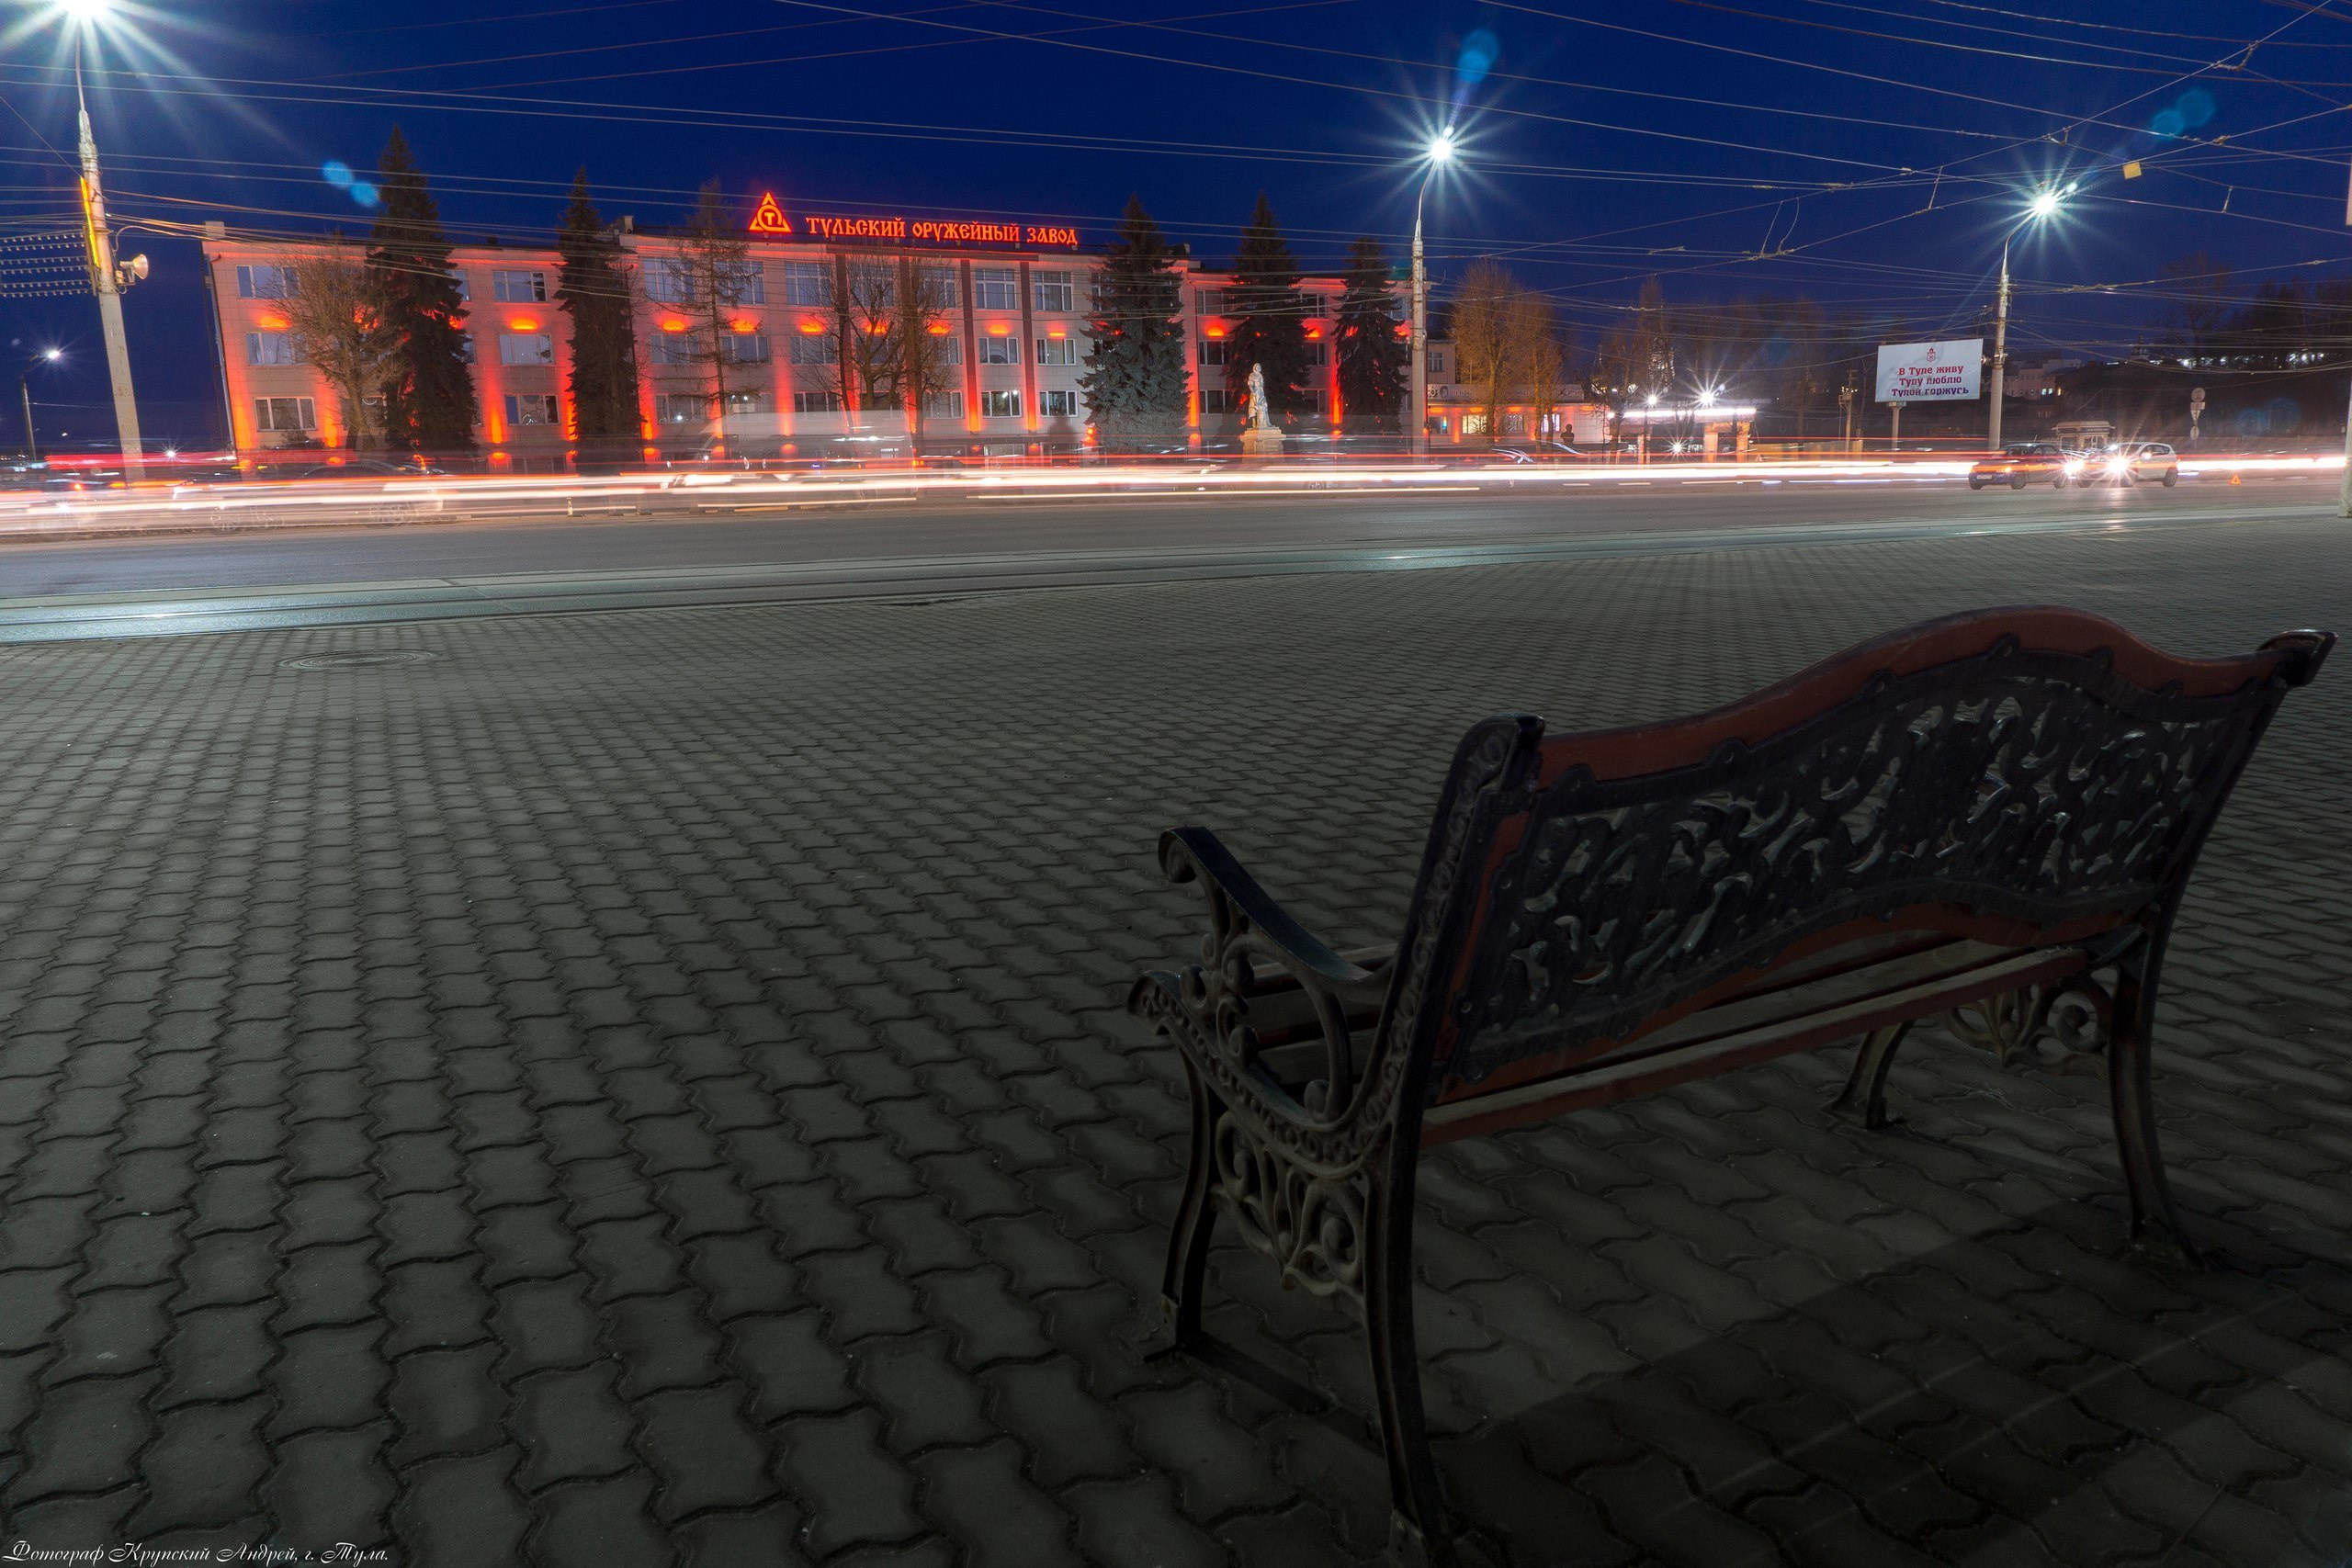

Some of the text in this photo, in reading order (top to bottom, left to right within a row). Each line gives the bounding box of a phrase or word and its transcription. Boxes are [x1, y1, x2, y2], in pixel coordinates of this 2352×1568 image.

[805, 216, 1078, 245] ТУЛЬСКИЙ ОРУЖЕЙНЫЙ ЗАВОД
[1898, 366, 1963, 376] В Туле живу
[1899, 376, 1962, 387] Тулу люблю
[1892, 387, 1969, 397] Тулой горжусь
